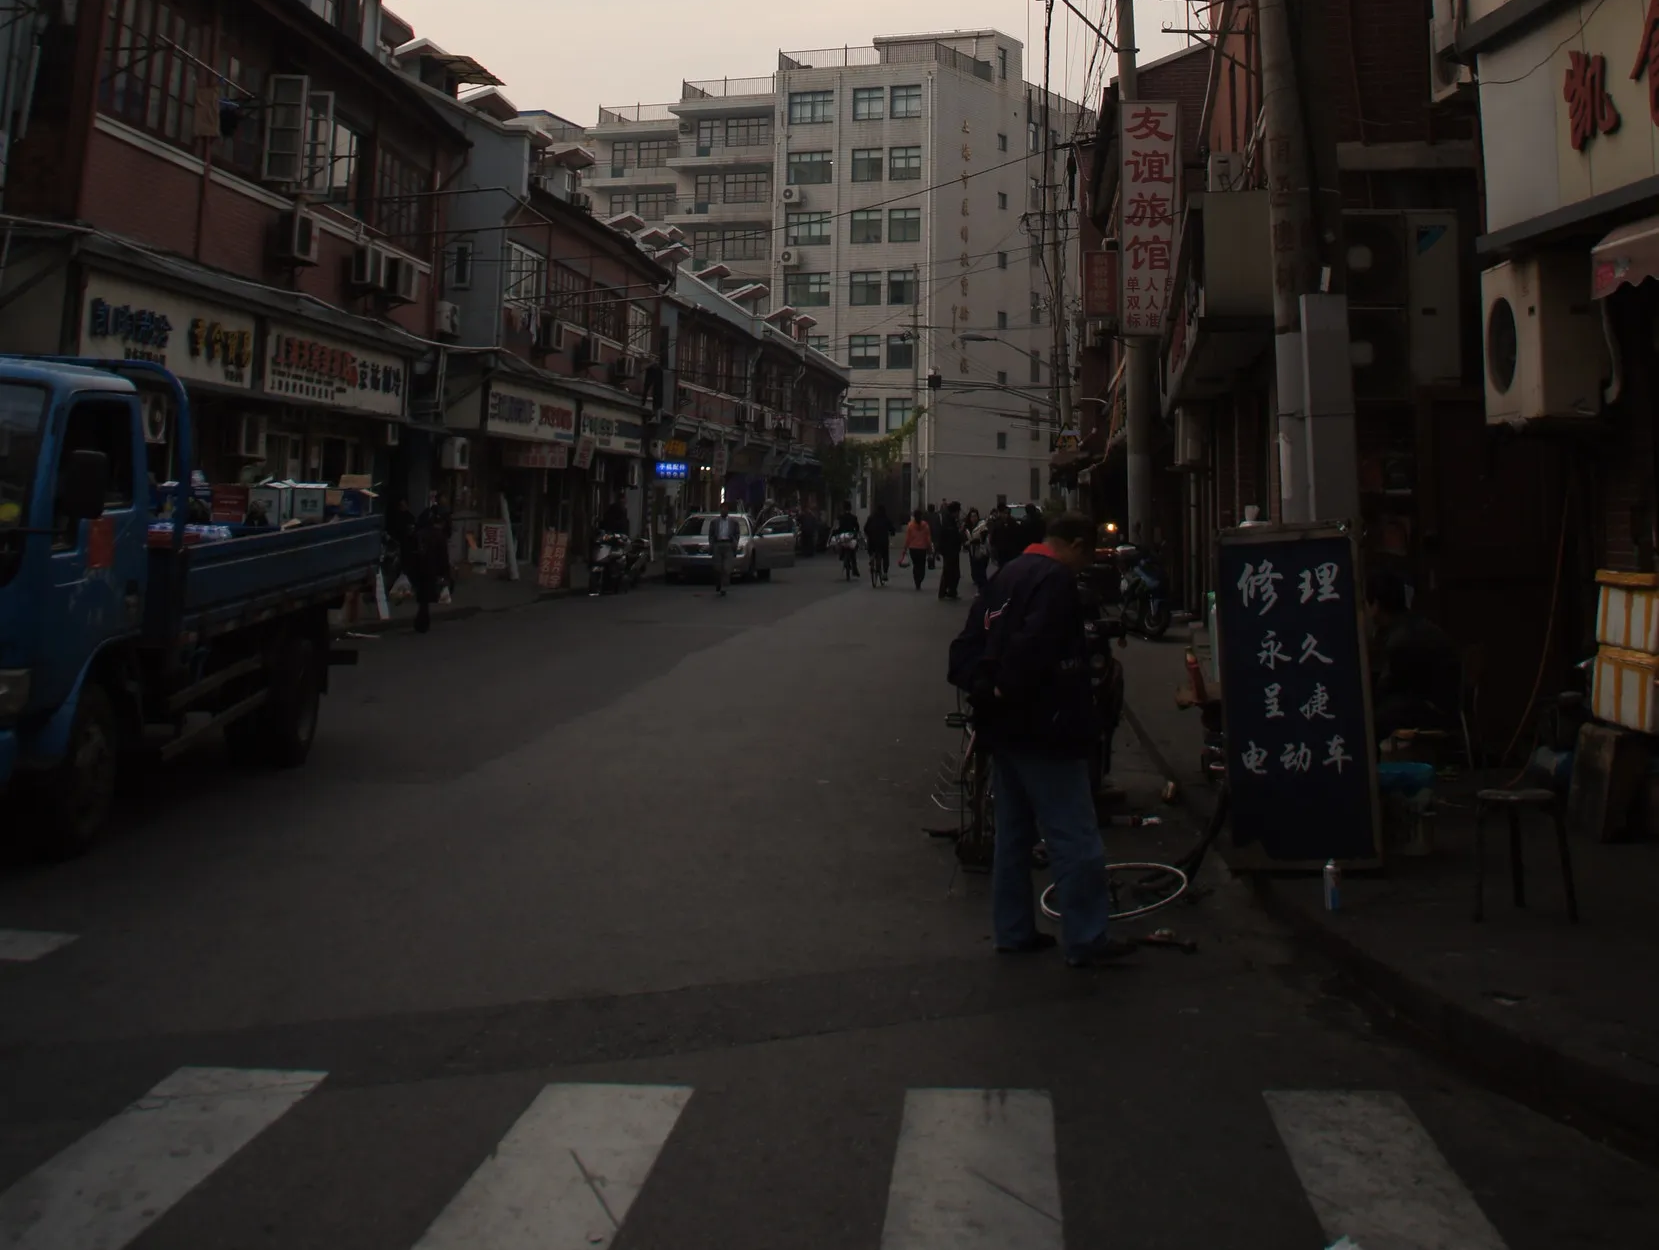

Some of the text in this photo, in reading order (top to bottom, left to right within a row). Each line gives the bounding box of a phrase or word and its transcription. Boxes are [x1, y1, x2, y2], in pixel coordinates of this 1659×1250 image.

[1125, 107, 1174, 271] 友谊旅馆
[1126, 296, 1170, 311] 双人
[1237, 559, 1341, 616] 修理
[1257, 630, 1334, 670] 永久
[1264, 682, 1336, 720] 呈捷
[1241, 734, 1353, 775] 电动车
